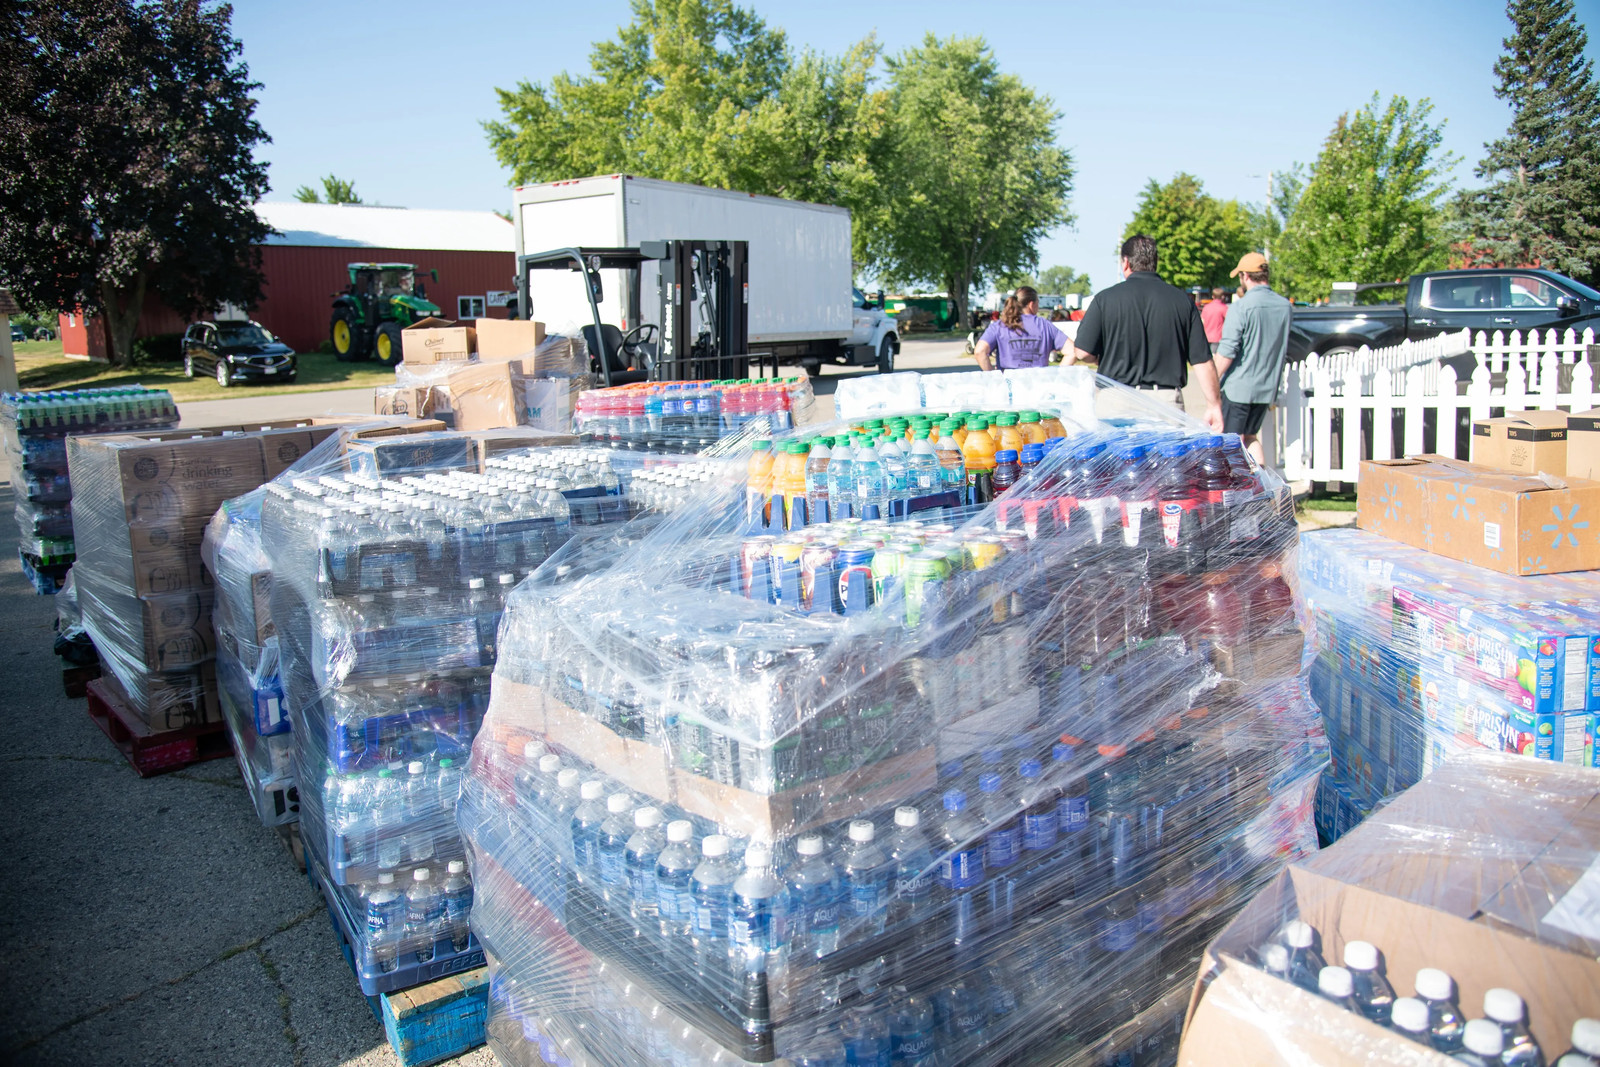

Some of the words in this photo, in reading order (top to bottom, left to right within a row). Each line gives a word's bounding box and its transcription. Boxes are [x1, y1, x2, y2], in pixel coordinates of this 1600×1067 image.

[182, 465, 233, 479] drinking
[182, 480, 220, 491] water
[442, 951, 484, 973] PEPSI
